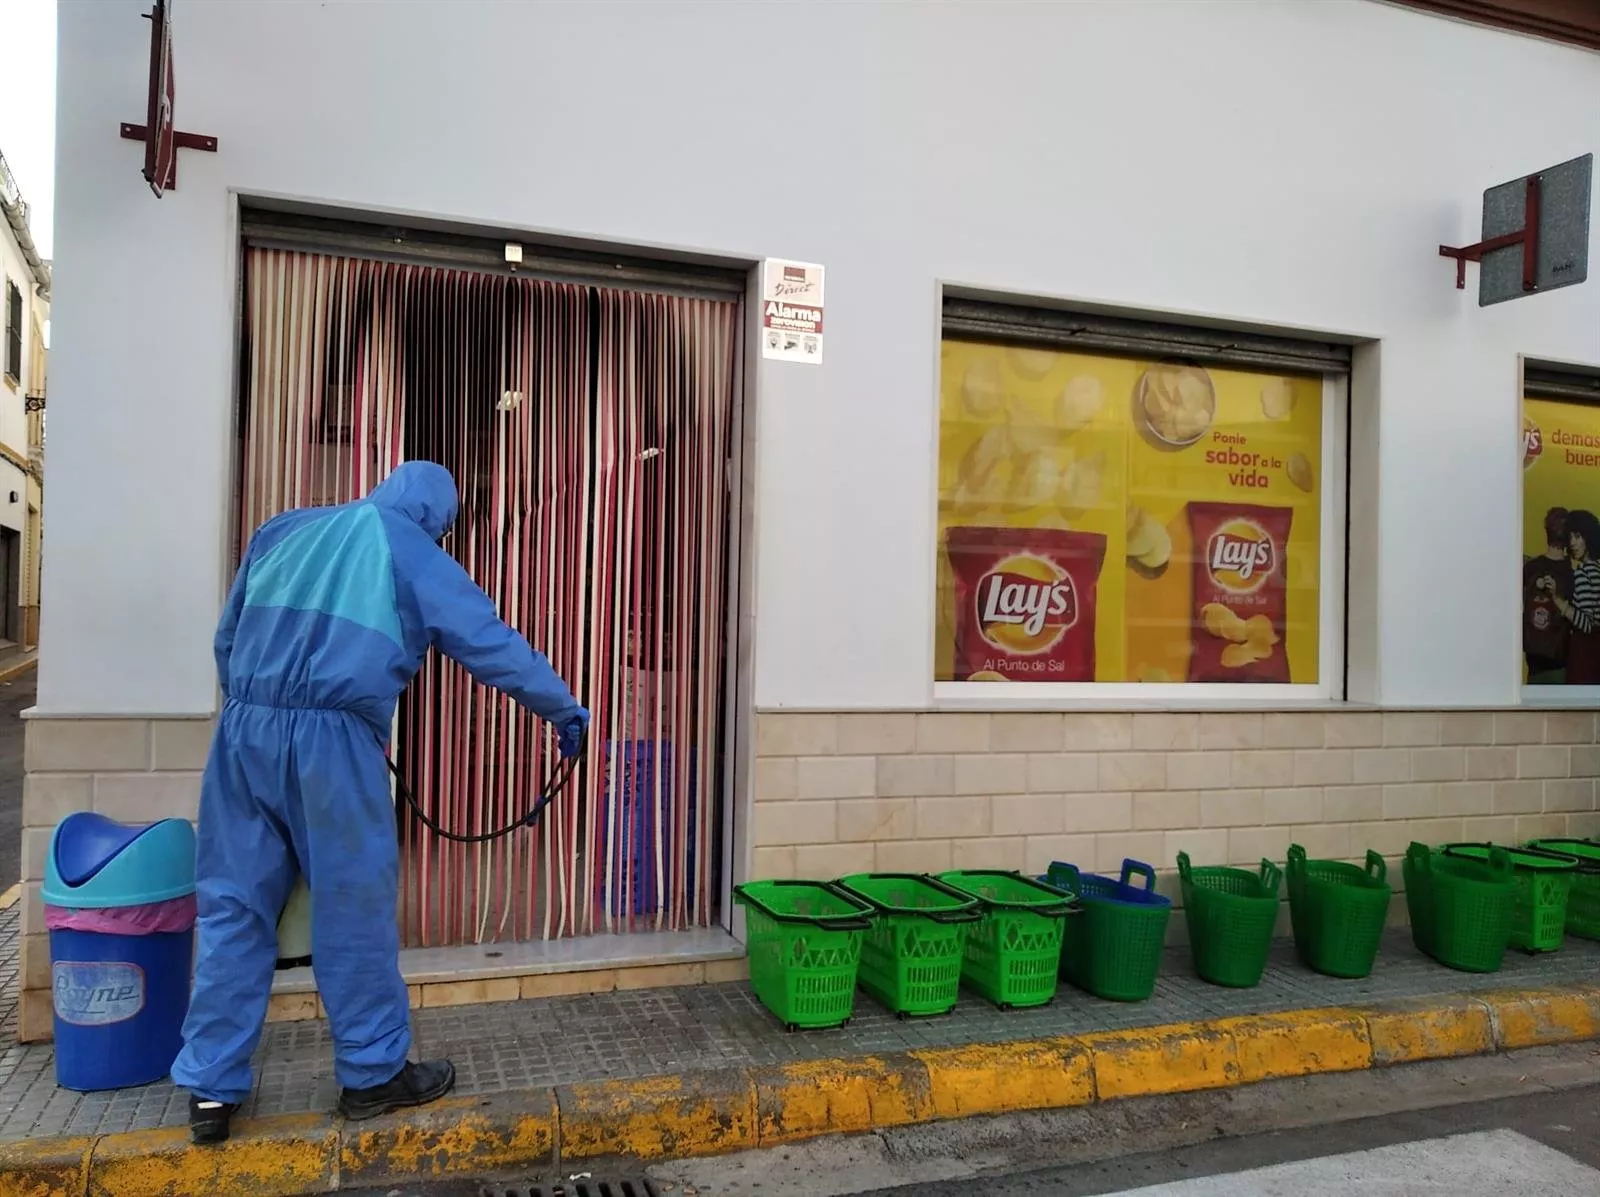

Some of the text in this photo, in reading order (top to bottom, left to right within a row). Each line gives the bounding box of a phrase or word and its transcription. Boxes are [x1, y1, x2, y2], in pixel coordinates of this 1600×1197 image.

[766, 301, 822, 323] Alarma
[1213, 431, 1247, 444] Ponle
[1206, 447, 1282, 468] sabor a la
[1228, 469, 1269, 488] vida
[1212, 535, 1270, 579] Lay's
[983, 575, 1070, 637] Lay's
[983, 659, 1066, 673] Al Punto de Sal
